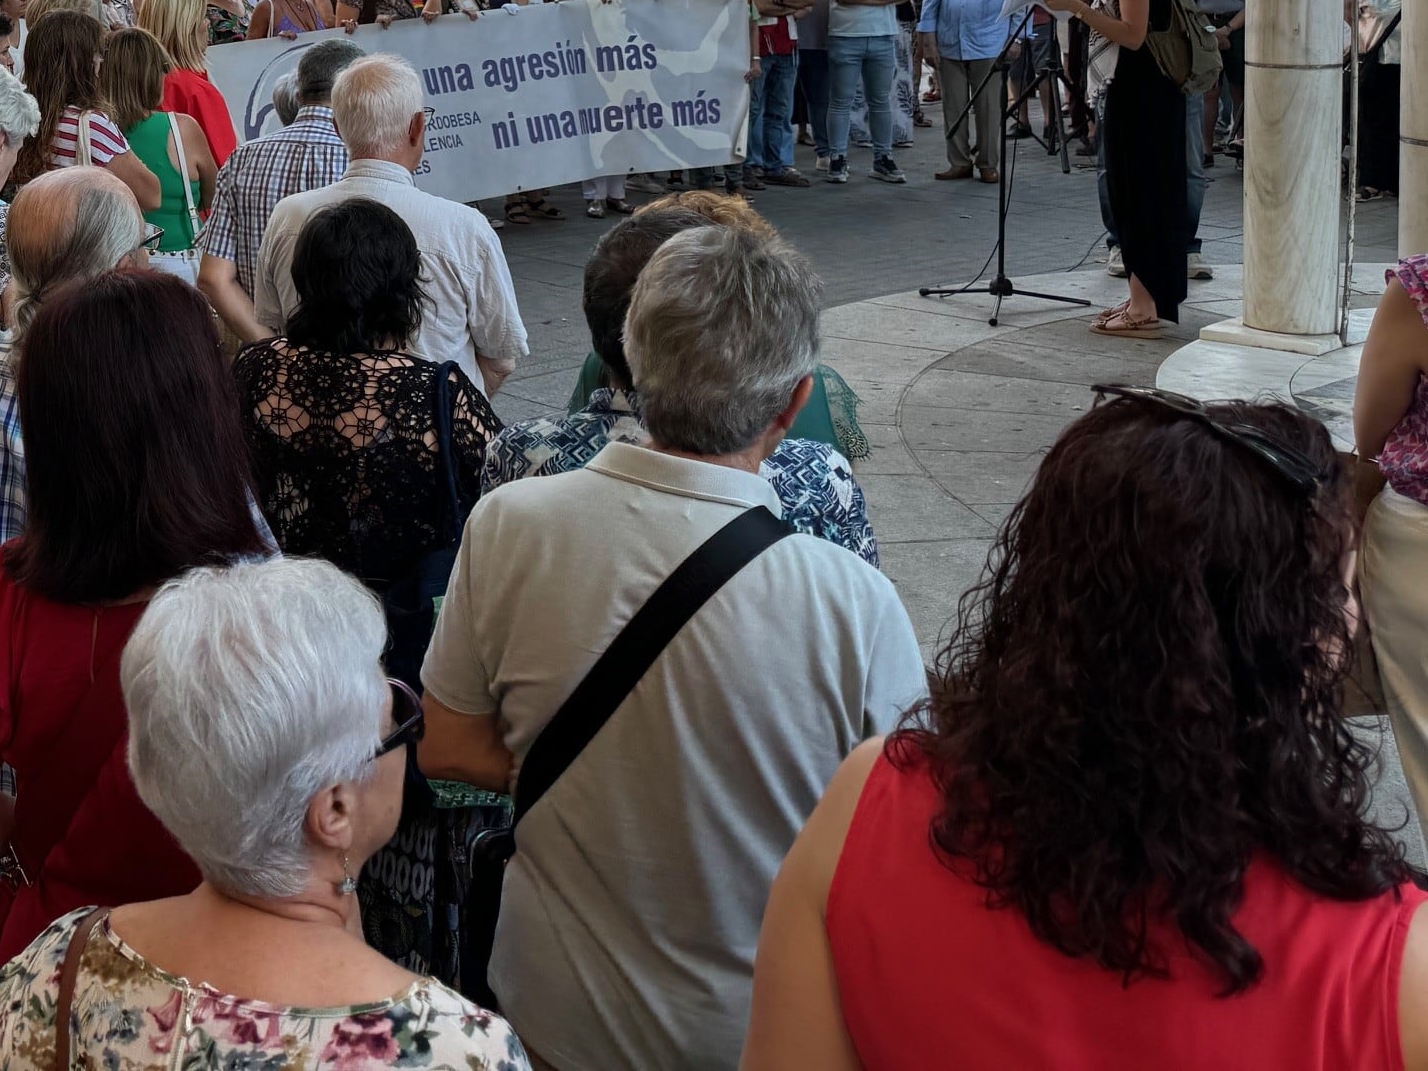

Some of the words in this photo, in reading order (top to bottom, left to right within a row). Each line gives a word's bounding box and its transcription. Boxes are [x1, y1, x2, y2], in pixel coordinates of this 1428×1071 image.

[422, 63, 475, 96] una
[482, 39, 587, 93] agresión
[596, 35, 657, 73] más
[425, 111, 482, 132] RDOBESA
[492, 112, 520, 149] ni
[526, 110, 578, 144] una
[578, 97, 663, 135] muerte
[672, 90, 721, 127] más
